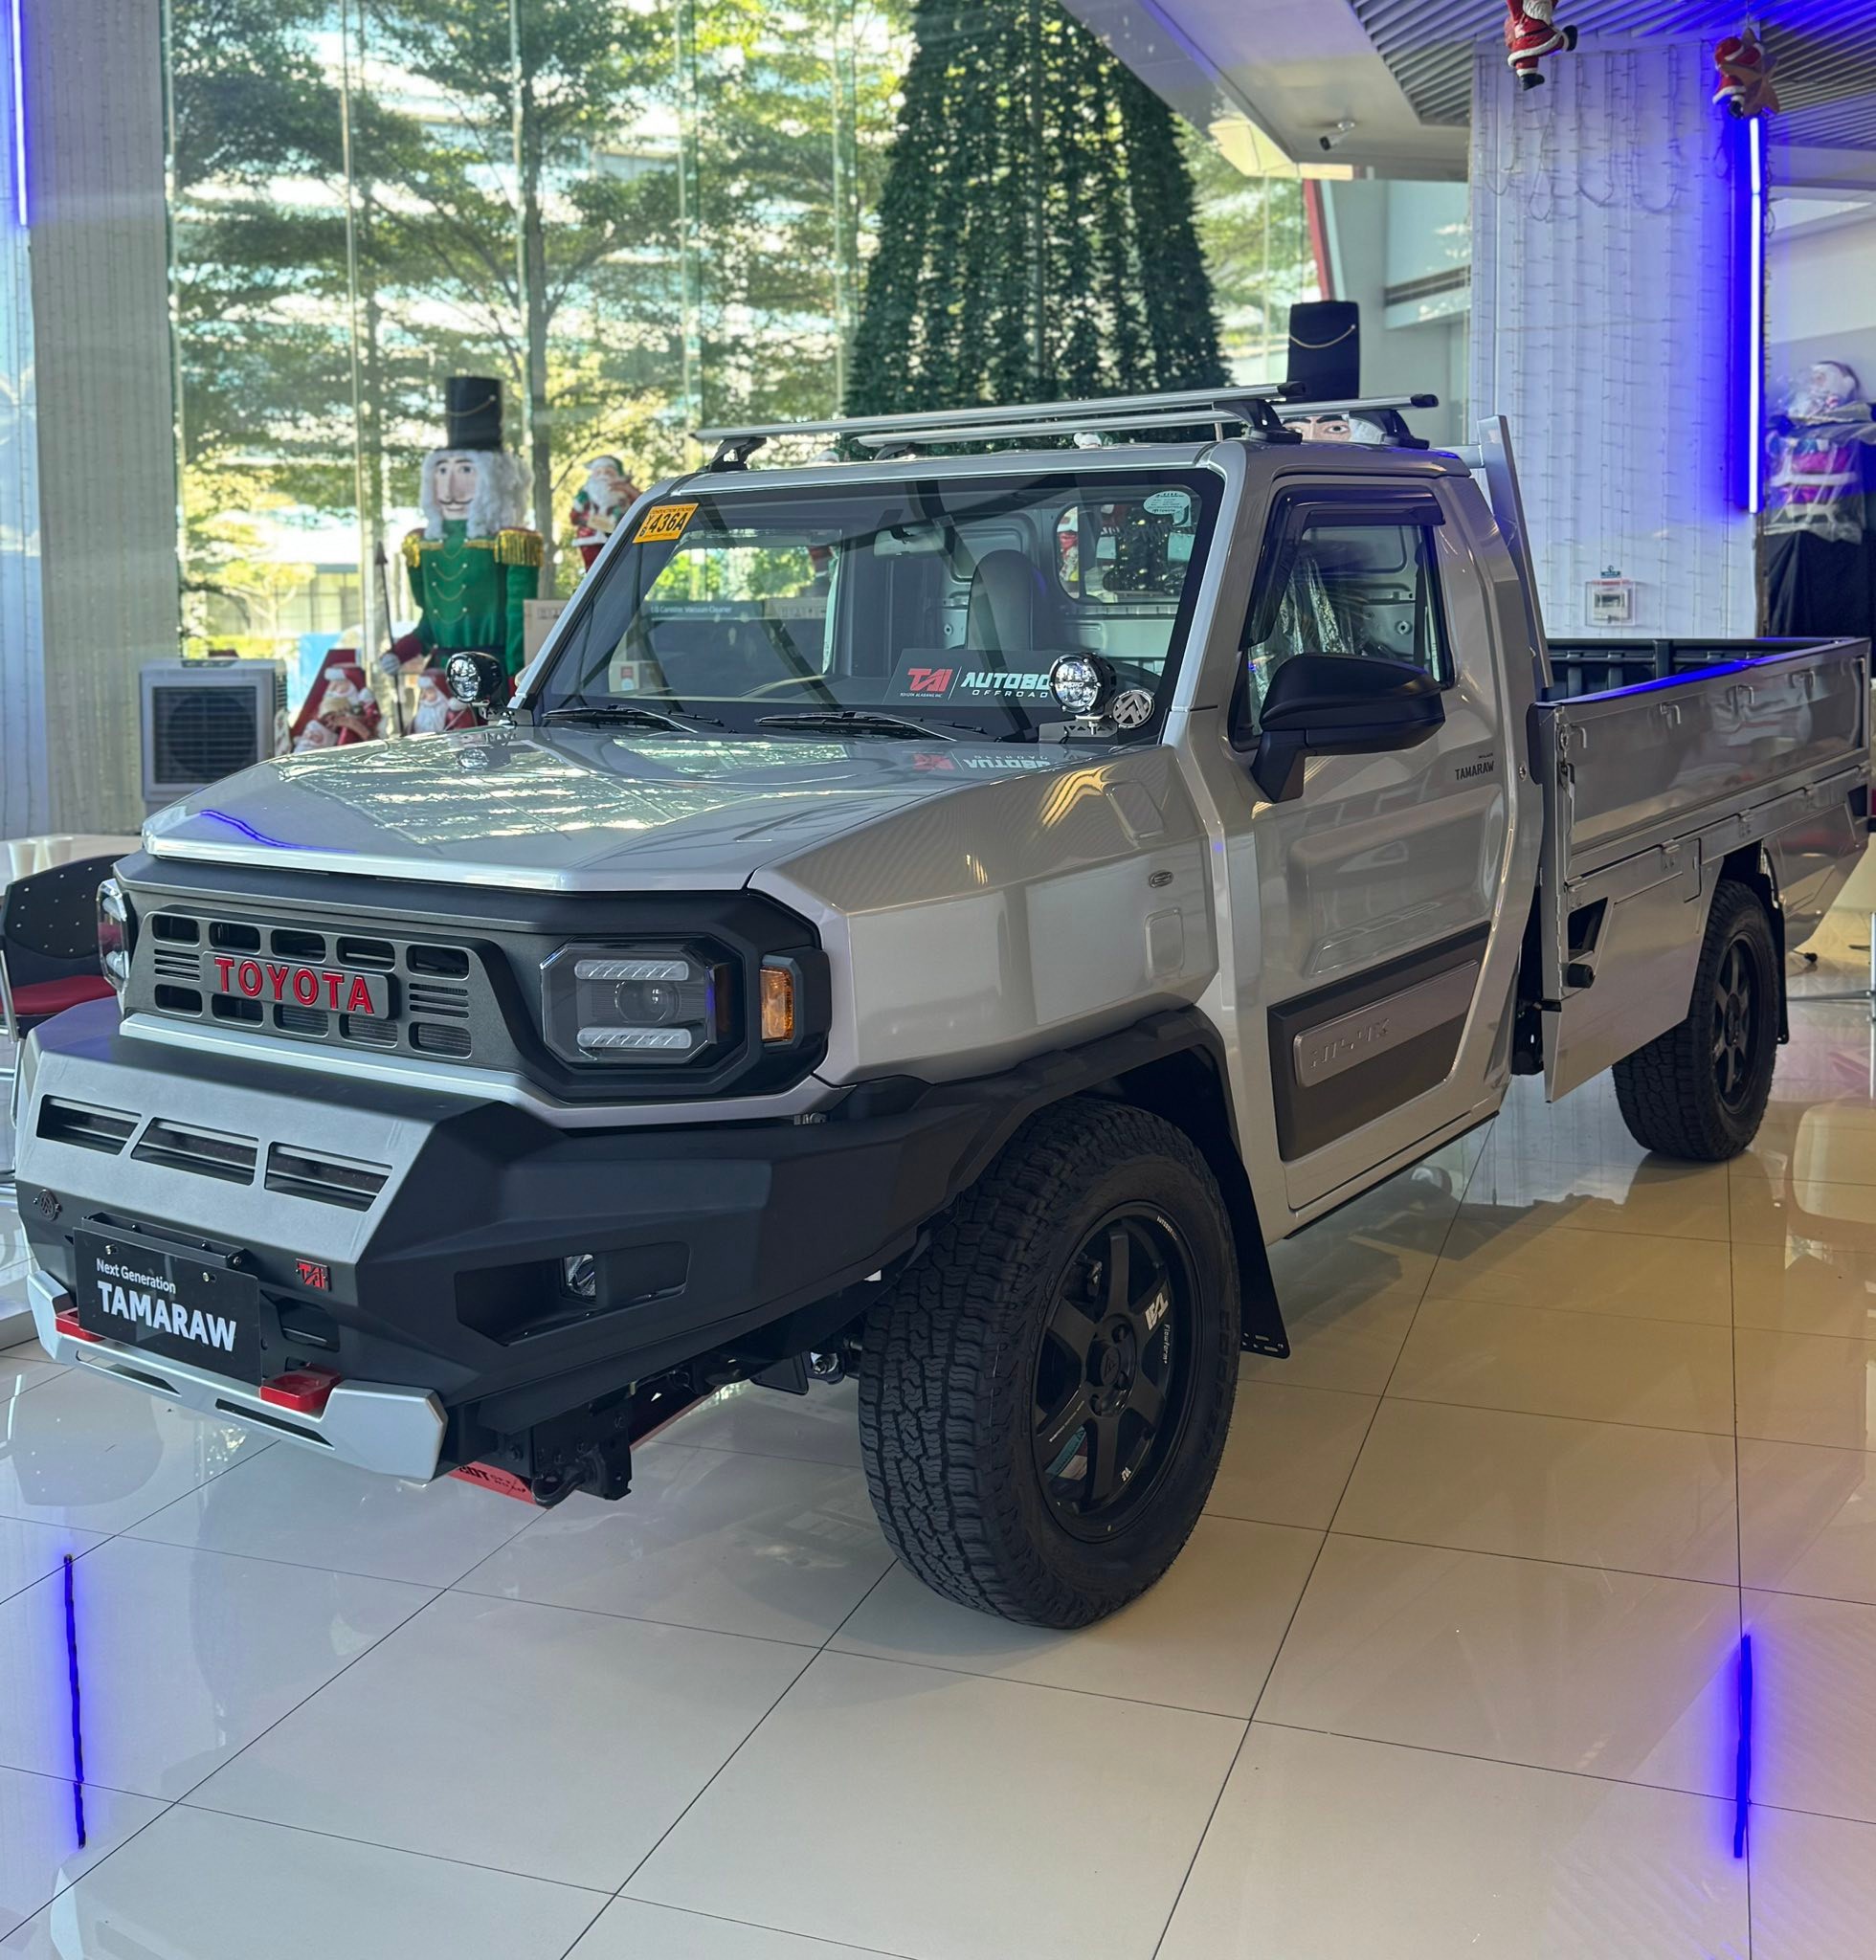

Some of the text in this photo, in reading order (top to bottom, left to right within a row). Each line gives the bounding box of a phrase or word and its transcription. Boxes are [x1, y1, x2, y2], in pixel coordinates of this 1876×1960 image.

[649, 512, 688, 533] 436A
[960, 672, 1051, 690] AUTOBO
[972, 689, 1048, 698] OFFROAD
[1455, 760, 1494, 780] TAMARAW
[214, 957, 375, 1015] TOYOTA
[96, 1258, 176, 1294] Next Generation
[97, 1280, 237, 1352] TAMARAW
